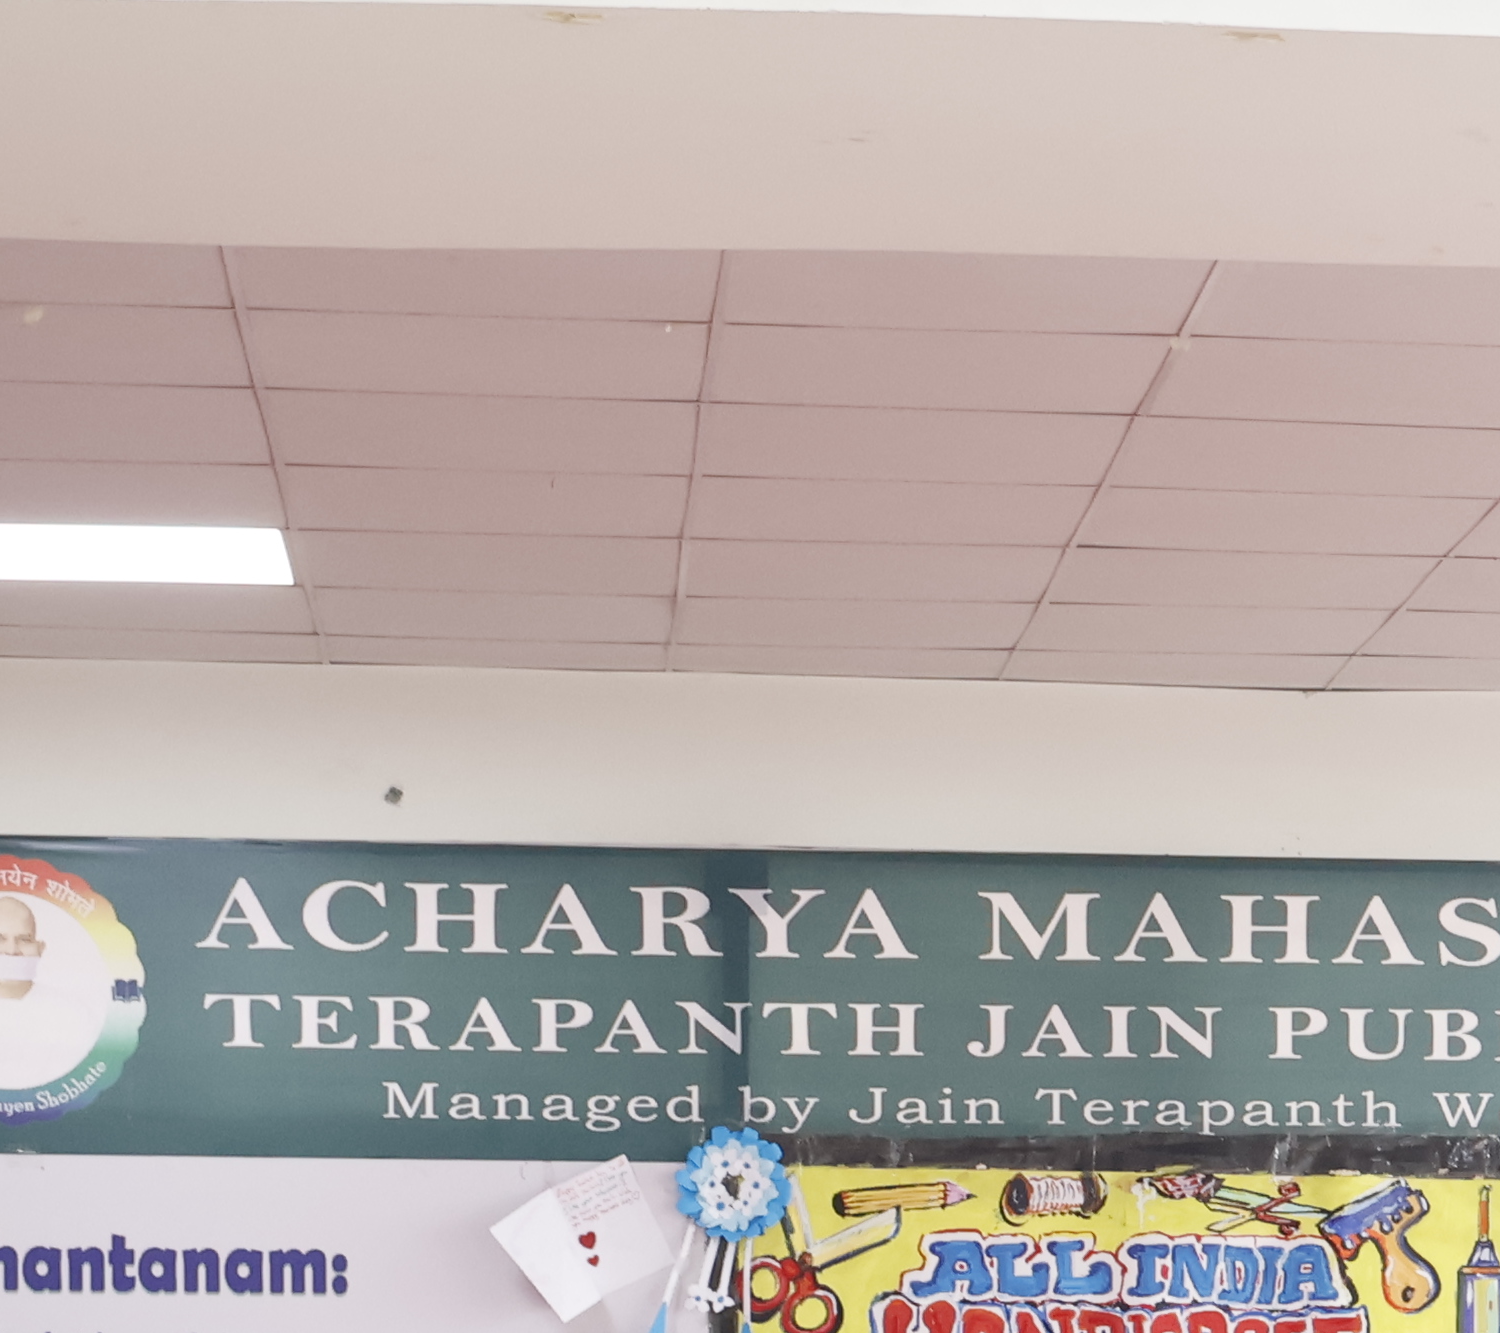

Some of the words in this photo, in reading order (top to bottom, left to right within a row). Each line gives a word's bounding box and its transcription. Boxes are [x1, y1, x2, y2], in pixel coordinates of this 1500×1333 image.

[46, 879, 97, 918] शोभते
[196, 877, 918, 960] ACHARYA
[203, 992, 925, 1057] TERAPANTH
[968, 1003, 1217, 1061] JAIN
[384, 1081, 702, 1130] Managed
[743, 1085, 818, 1131] by
[849, 1086, 1004, 1126] Jain
[1035, 1088, 1401, 1134] Terapanth
[907, 1238, 1112, 1299] ALL
[1125, 1236, 1341, 1304] INDIA
